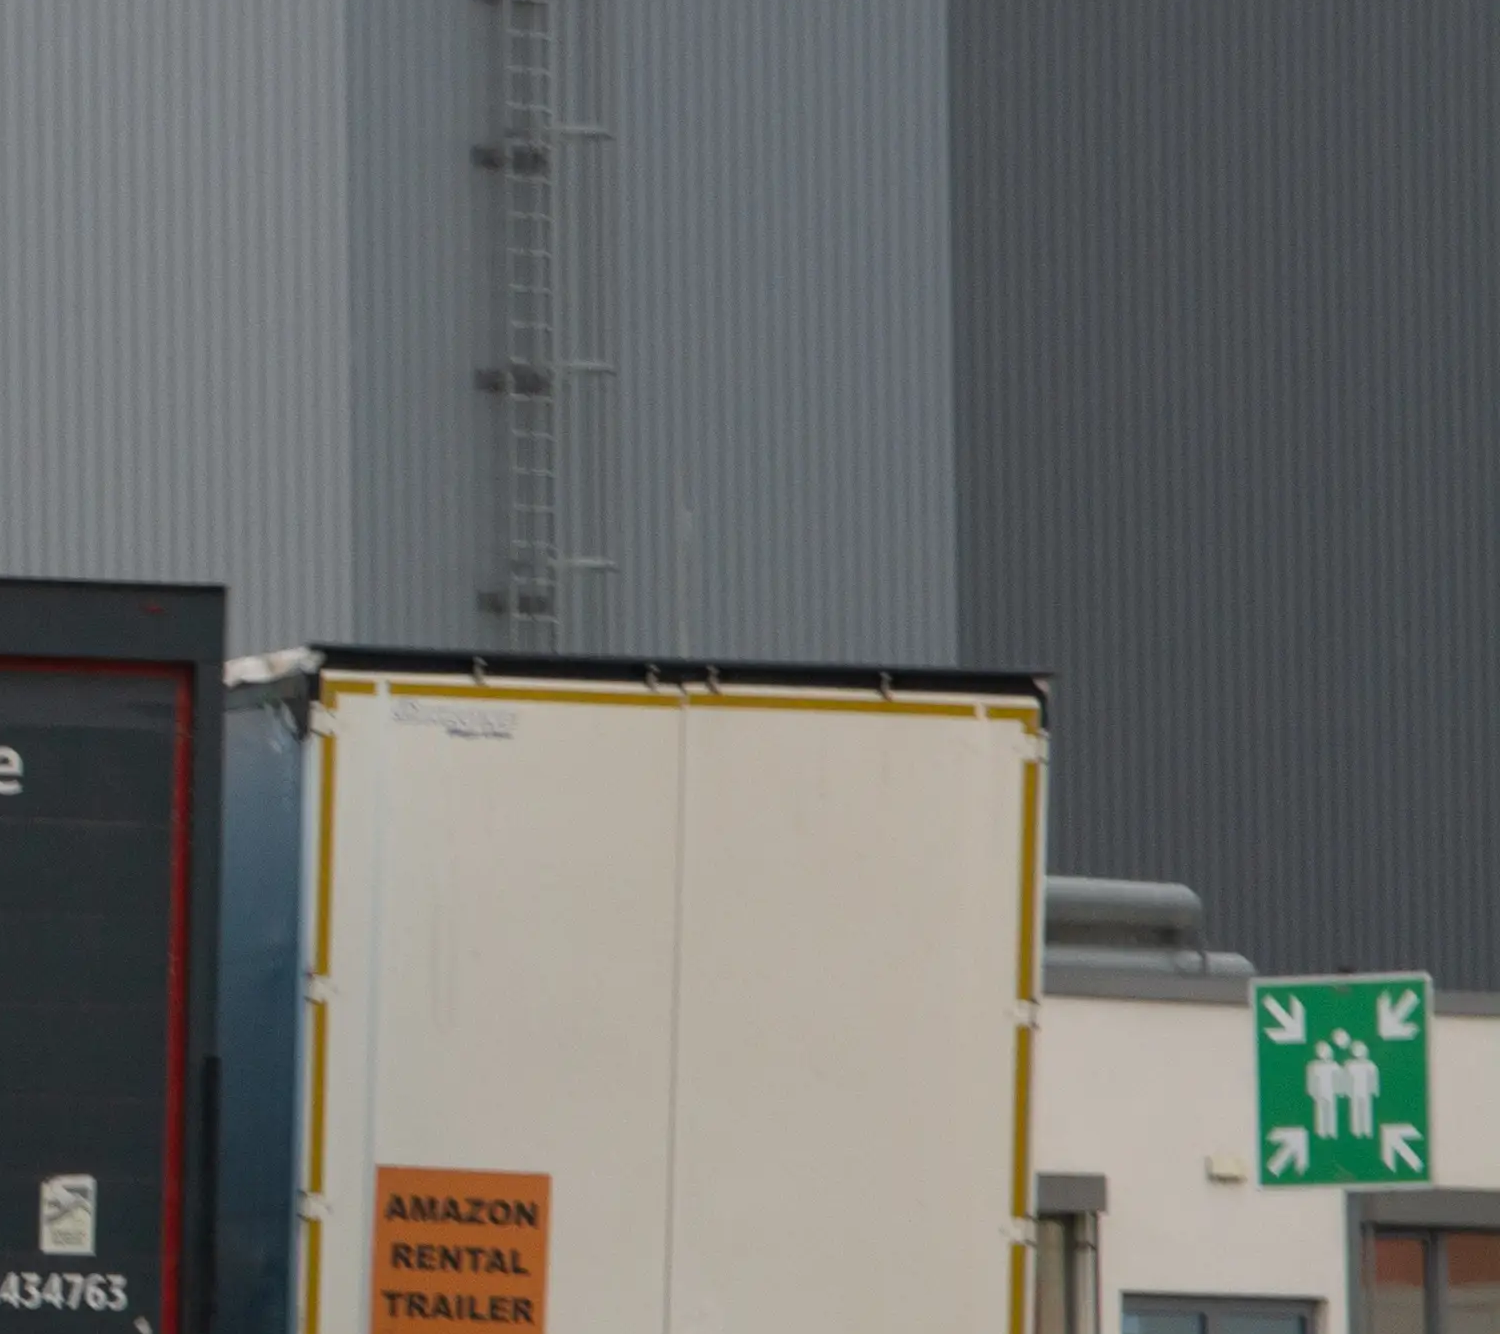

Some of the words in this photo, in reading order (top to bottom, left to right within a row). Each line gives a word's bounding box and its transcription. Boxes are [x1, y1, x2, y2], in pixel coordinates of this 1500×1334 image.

[384, 1193, 539, 1228] AMAZON
[390, 1242, 529, 1275] RENTAL
[381, 1289, 534, 1324] TRAILER
